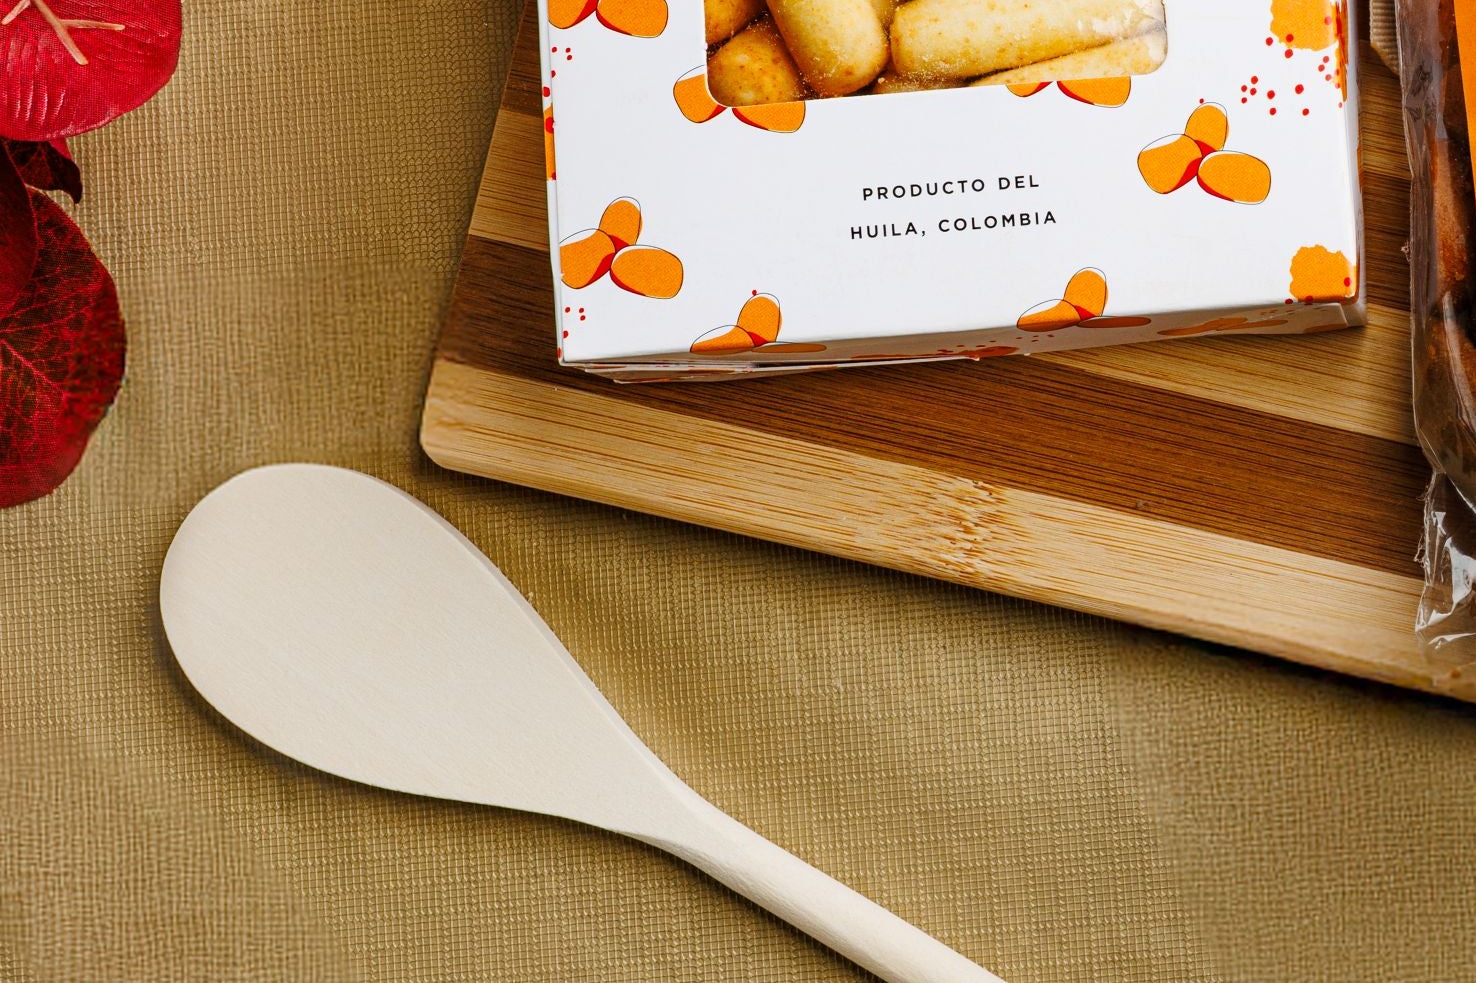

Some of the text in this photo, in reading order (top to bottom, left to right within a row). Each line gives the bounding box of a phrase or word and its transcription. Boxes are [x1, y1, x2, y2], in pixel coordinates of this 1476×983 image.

[862, 175, 1040, 201] PRODUCTO DEL
[850, 210, 1057, 240] HUILA, COLOMBIA
